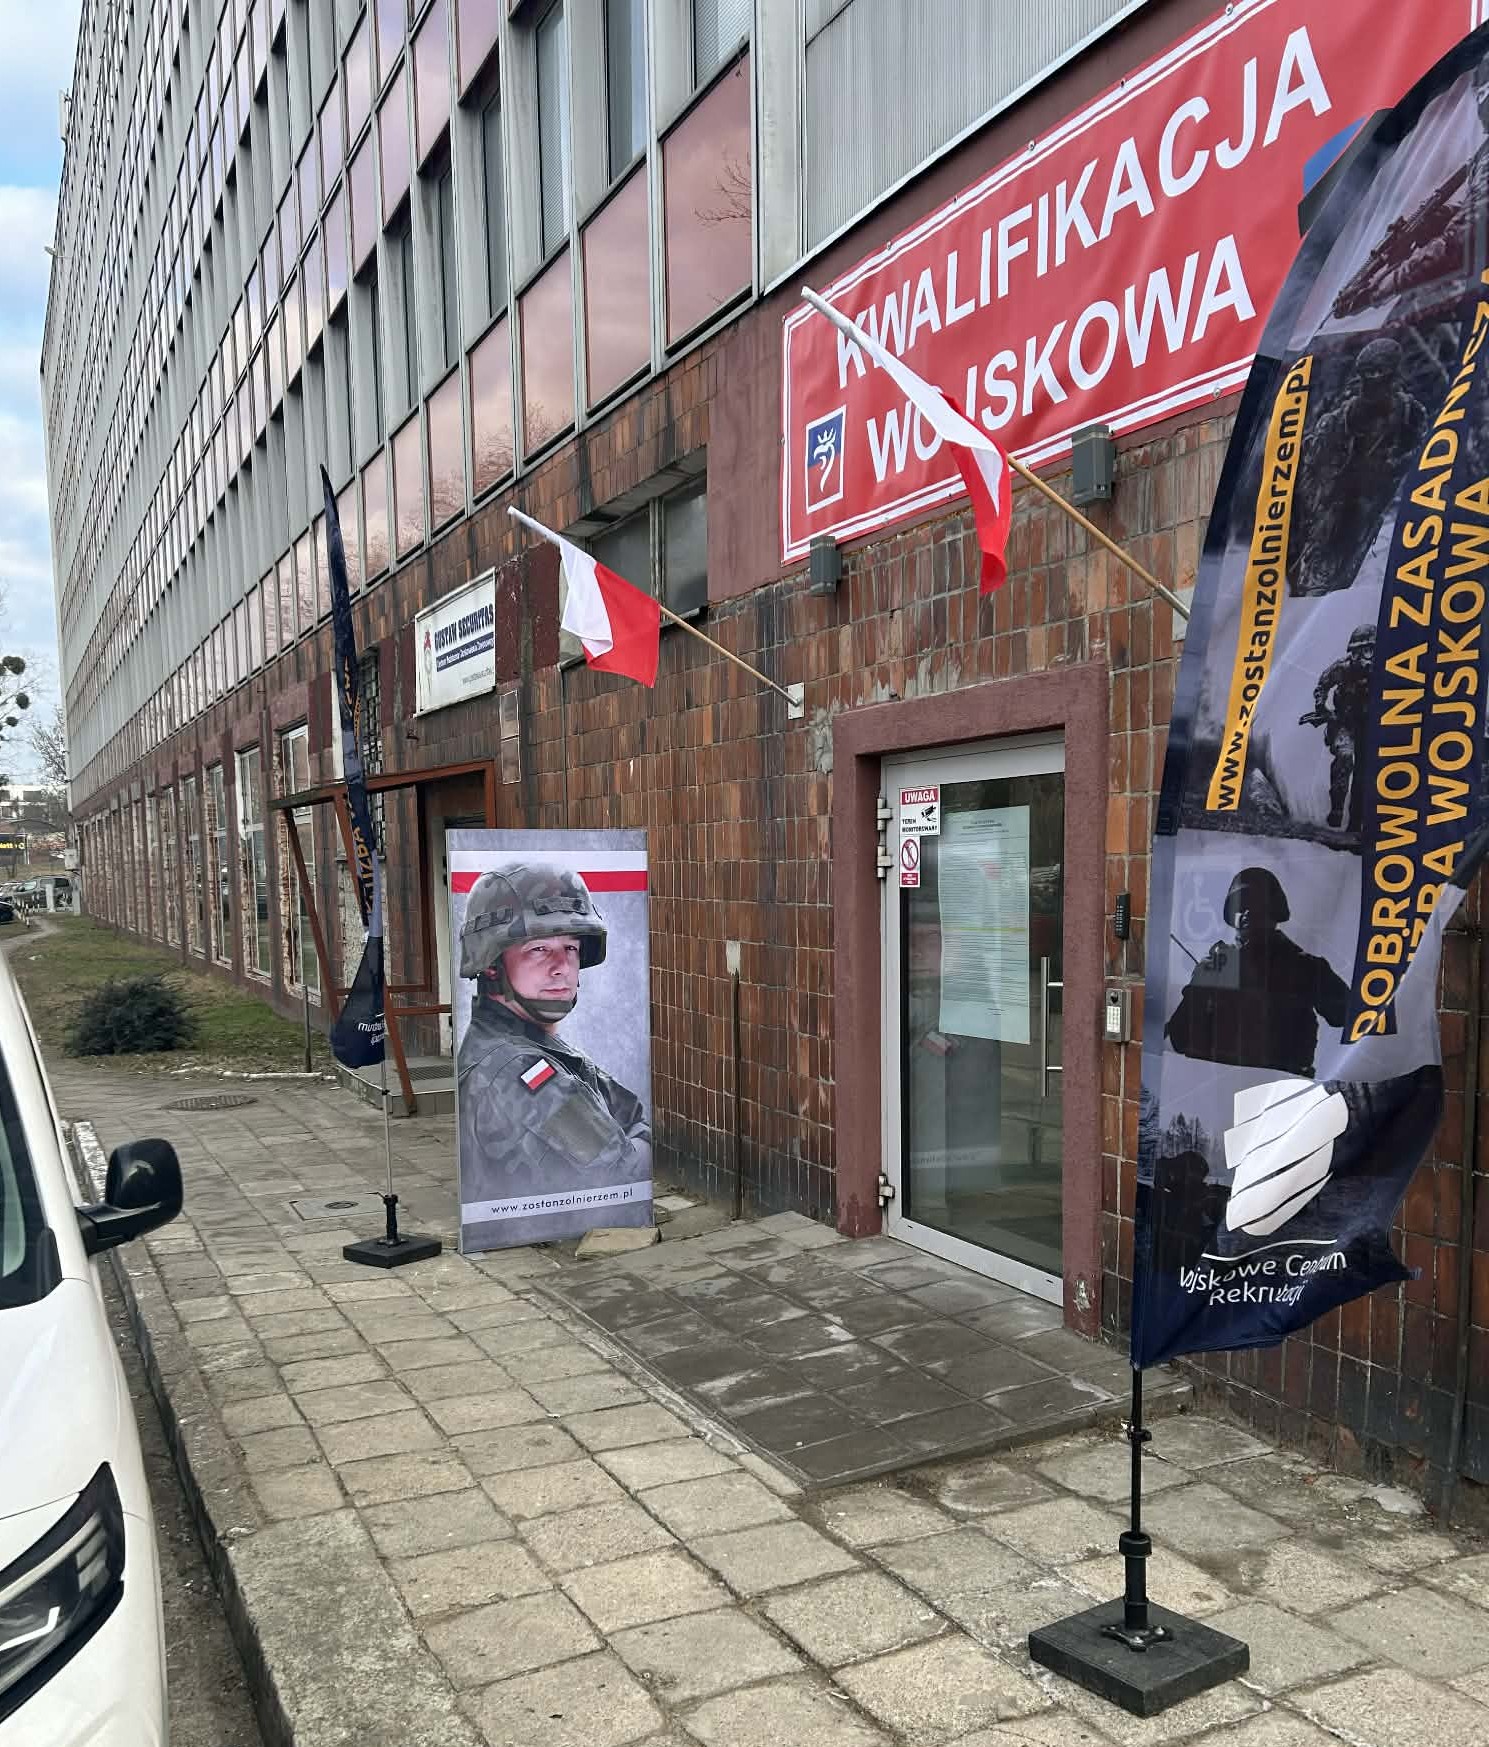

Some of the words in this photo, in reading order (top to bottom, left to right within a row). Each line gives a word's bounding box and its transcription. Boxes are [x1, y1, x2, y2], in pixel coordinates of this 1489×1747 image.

[837, 26, 1331, 389] KWALIFIKACJA
[867, 234, 1257, 484] WOJSKOWA
[458, 603, 494, 639] SECURITAS
[1217, 356, 1311, 810] www.zostanzolnierzem.pl
[1350, 643, 1428, 1041] DOBROWOLNA
[1390, 267, 1489, 628] ZASADNICZ
[1426, 477, 1489, 826] WOJSKOWA
[904, 790, 935, 803] UWAGA
[491, 1186, 634, 1214] www.zostanzolnierzem.pl
